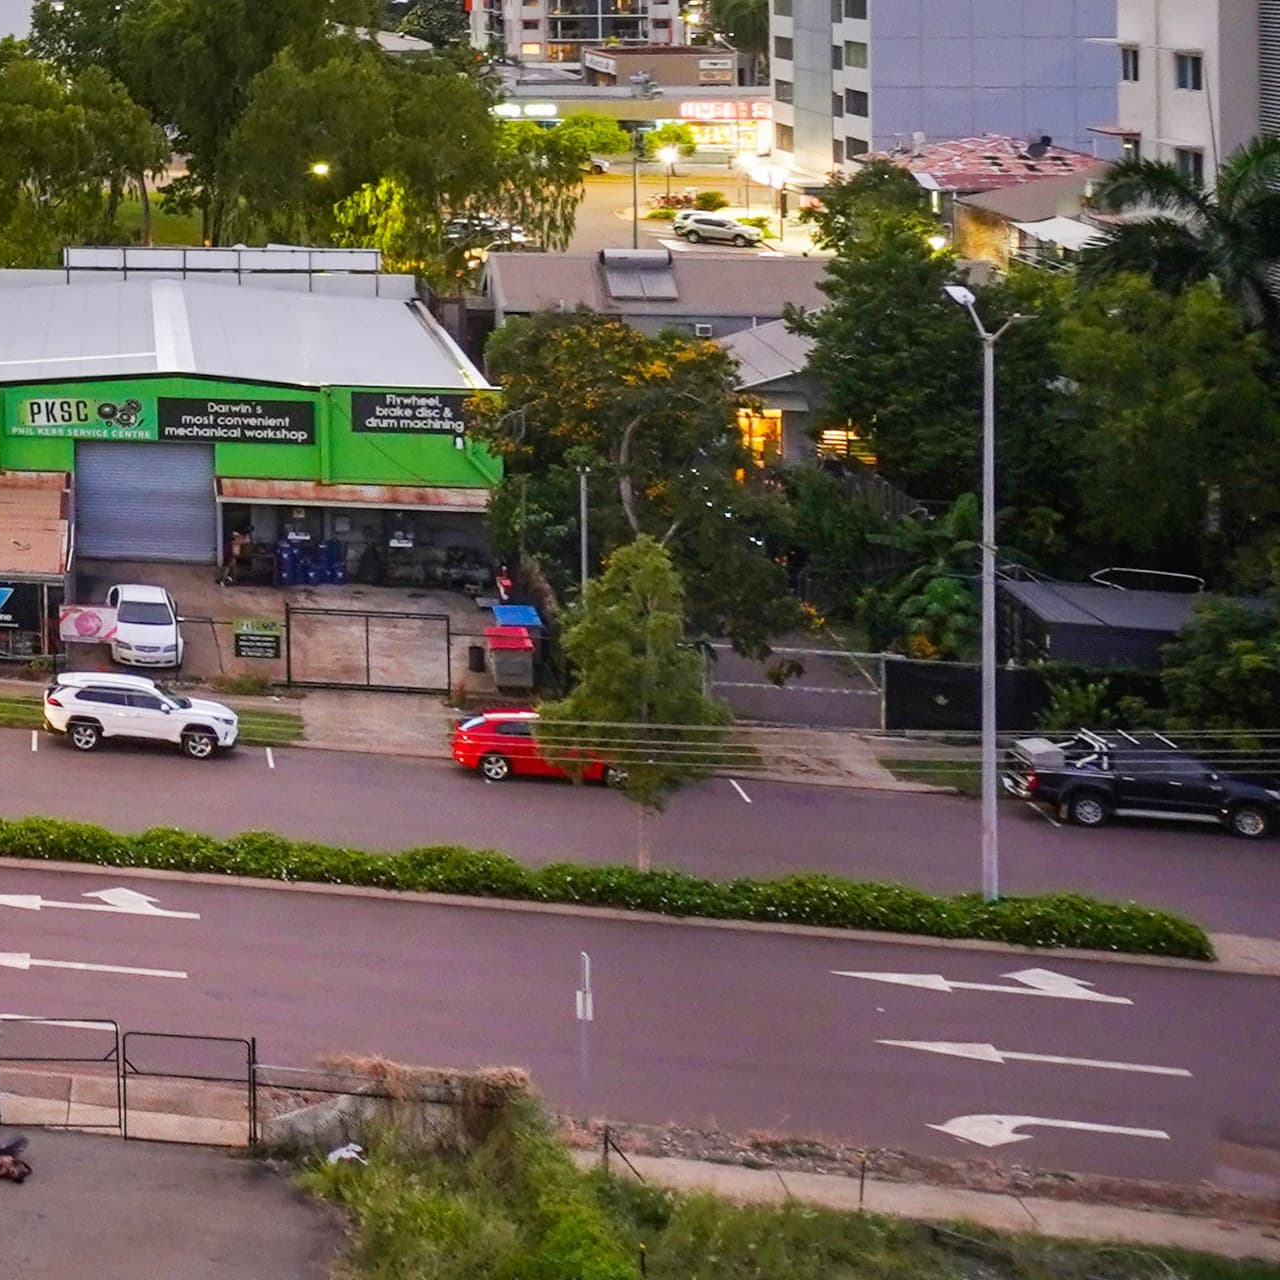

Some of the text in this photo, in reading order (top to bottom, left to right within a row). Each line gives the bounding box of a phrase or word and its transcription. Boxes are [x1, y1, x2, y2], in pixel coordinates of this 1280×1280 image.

[29, 400, 89, 423] PKSC
[375, 405, 453, 418] brake disc &
[181, 414, 290, 427] most convenient
[365, 417, 465, 433] drum machining
[11, 427, 35, 436] PHIL
[66, 428, 108, 438] SERVICE
[111, 429, 152, 439] CENTRE
[164, 426, 308, 442] mechanical workshop
